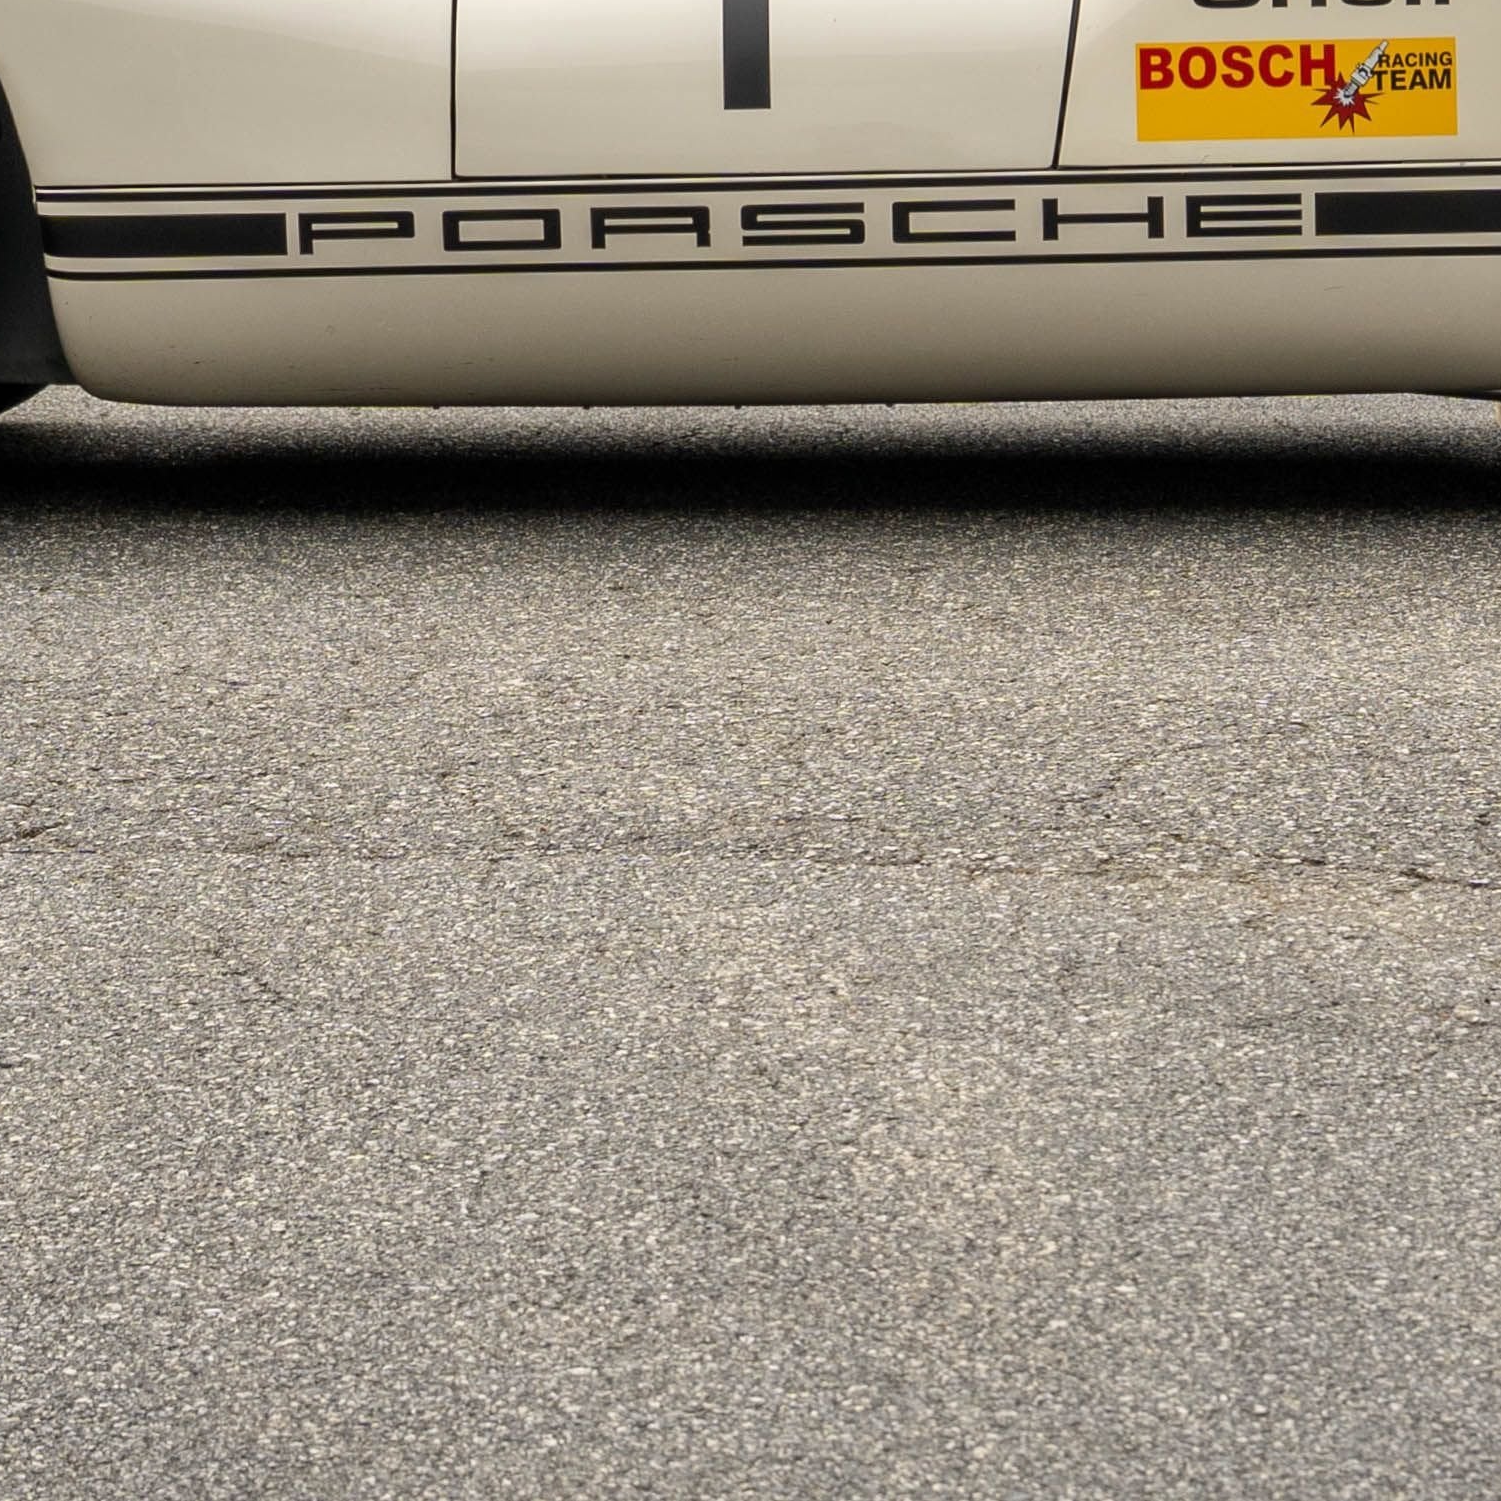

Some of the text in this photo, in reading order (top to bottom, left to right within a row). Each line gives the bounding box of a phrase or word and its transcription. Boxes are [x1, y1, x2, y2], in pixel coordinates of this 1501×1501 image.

[1139, 44, 1452, 90] BOSCH RACING
[1374, 68, 1452, 91] TEAM
[298, 193, 1302, 255] PORSCHE
